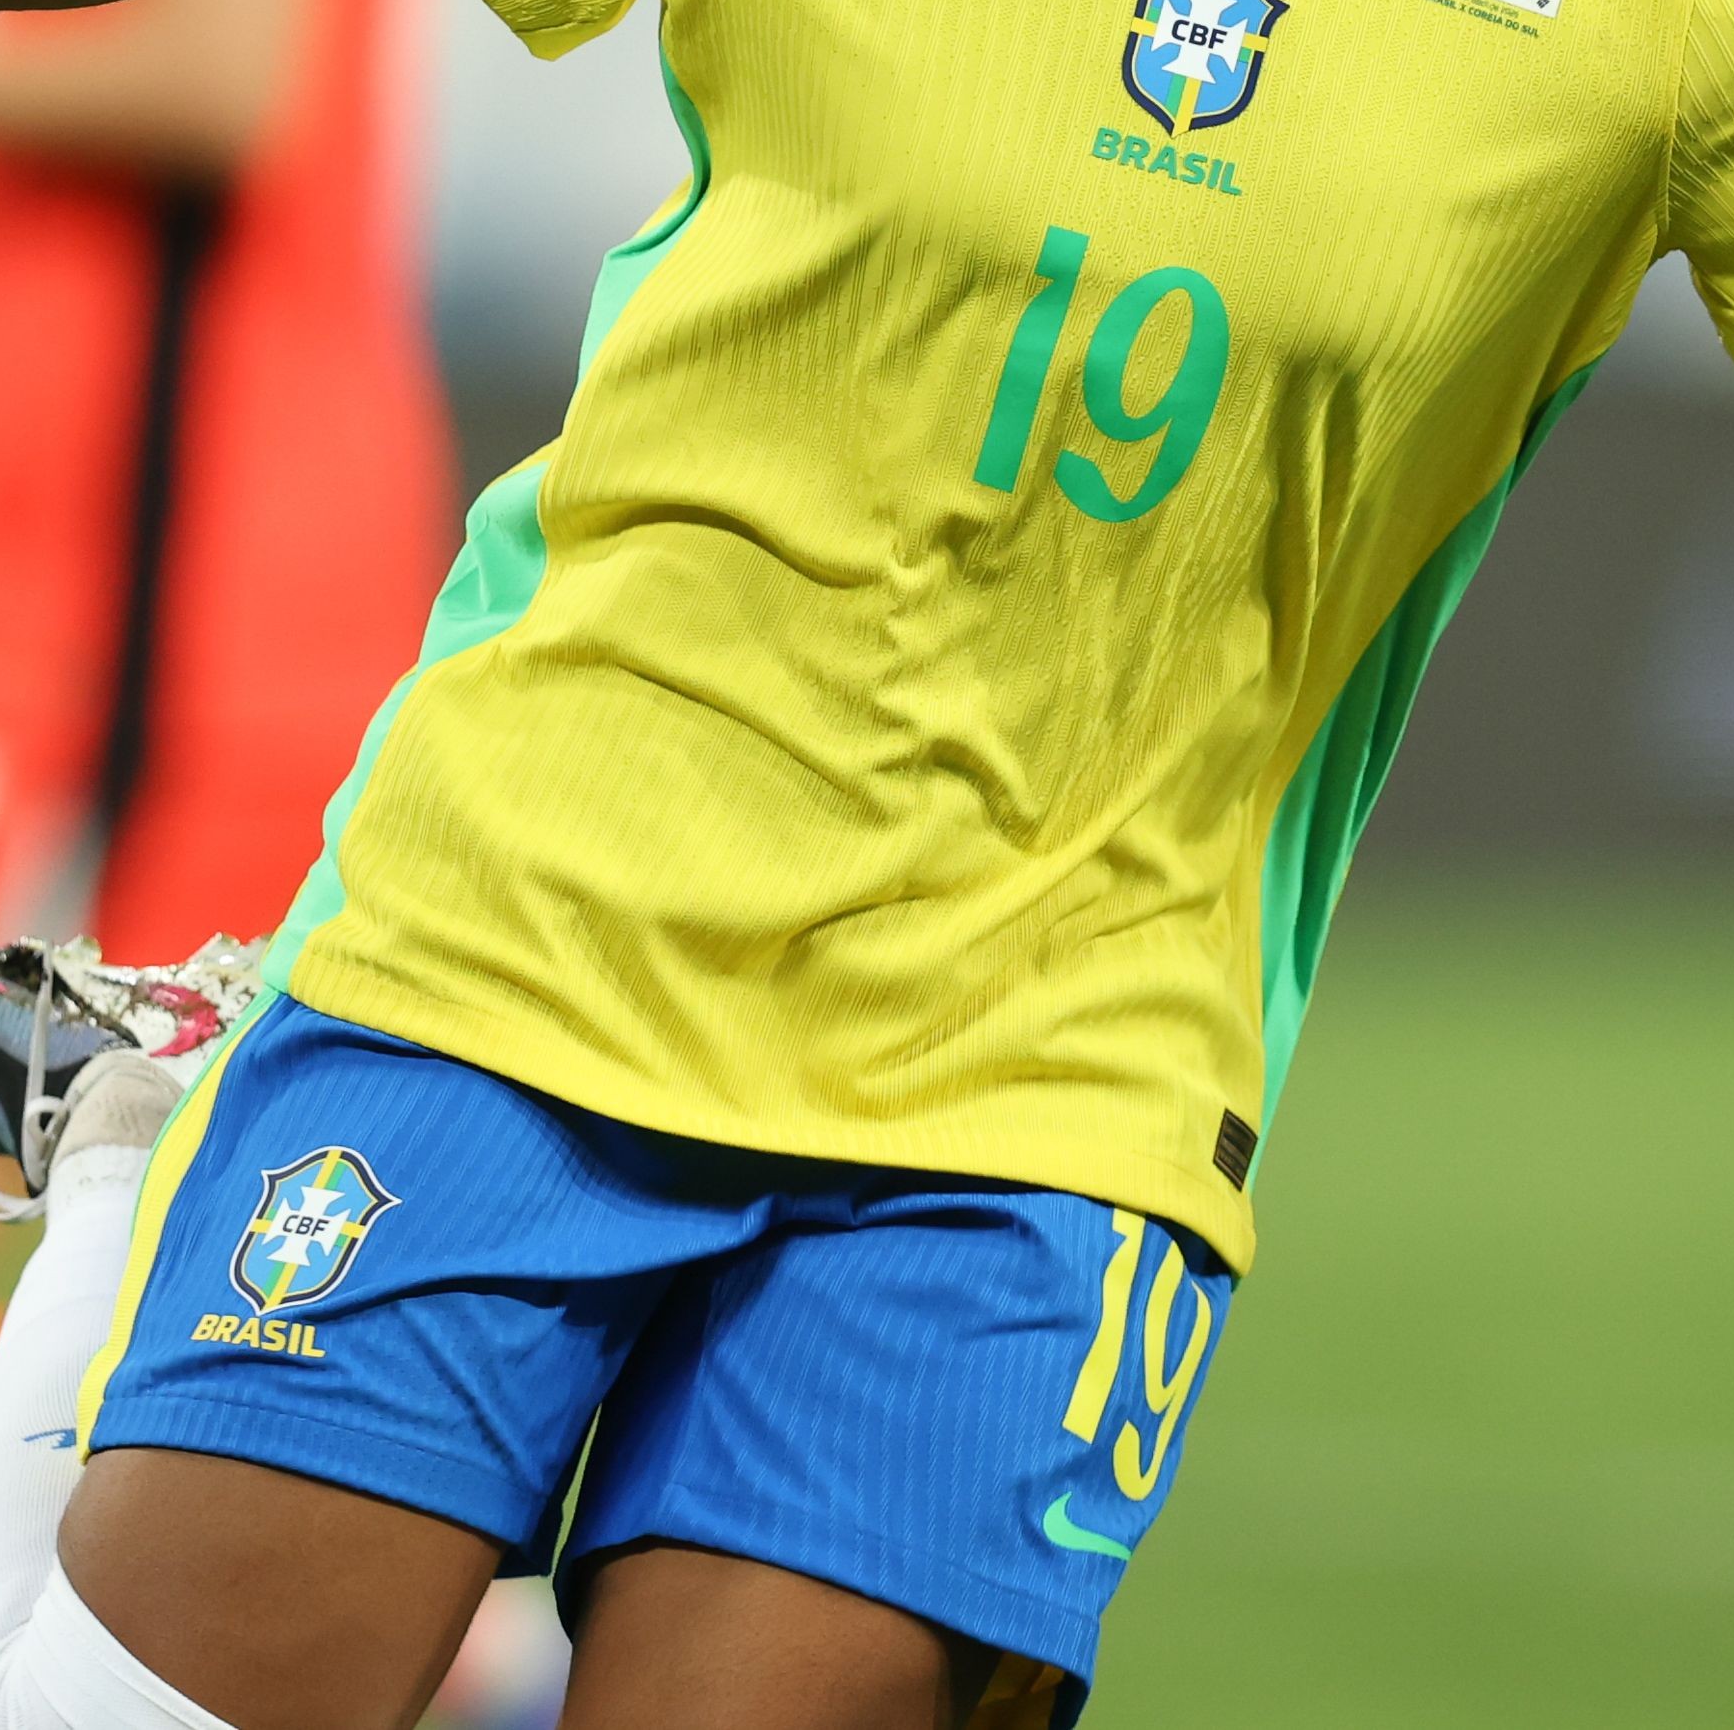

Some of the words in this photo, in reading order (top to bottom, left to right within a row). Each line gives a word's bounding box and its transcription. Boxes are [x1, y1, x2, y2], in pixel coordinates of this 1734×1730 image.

[1171, 19, 1228, 50] CBF
[1468, 5, 1503, 26] COREIA
[1504, 17, 1520, 31] DO
[1521, 24, 1540, 38] SUL
[1091, 127, 1243, 196] BRASIL
[972, 225, 1230, 524] 19
[282, 1215, 331, 1237] CBF
[191, 1313, 326, 1359] BRASIL
[1062, 1206, 1211, 1500] 19
